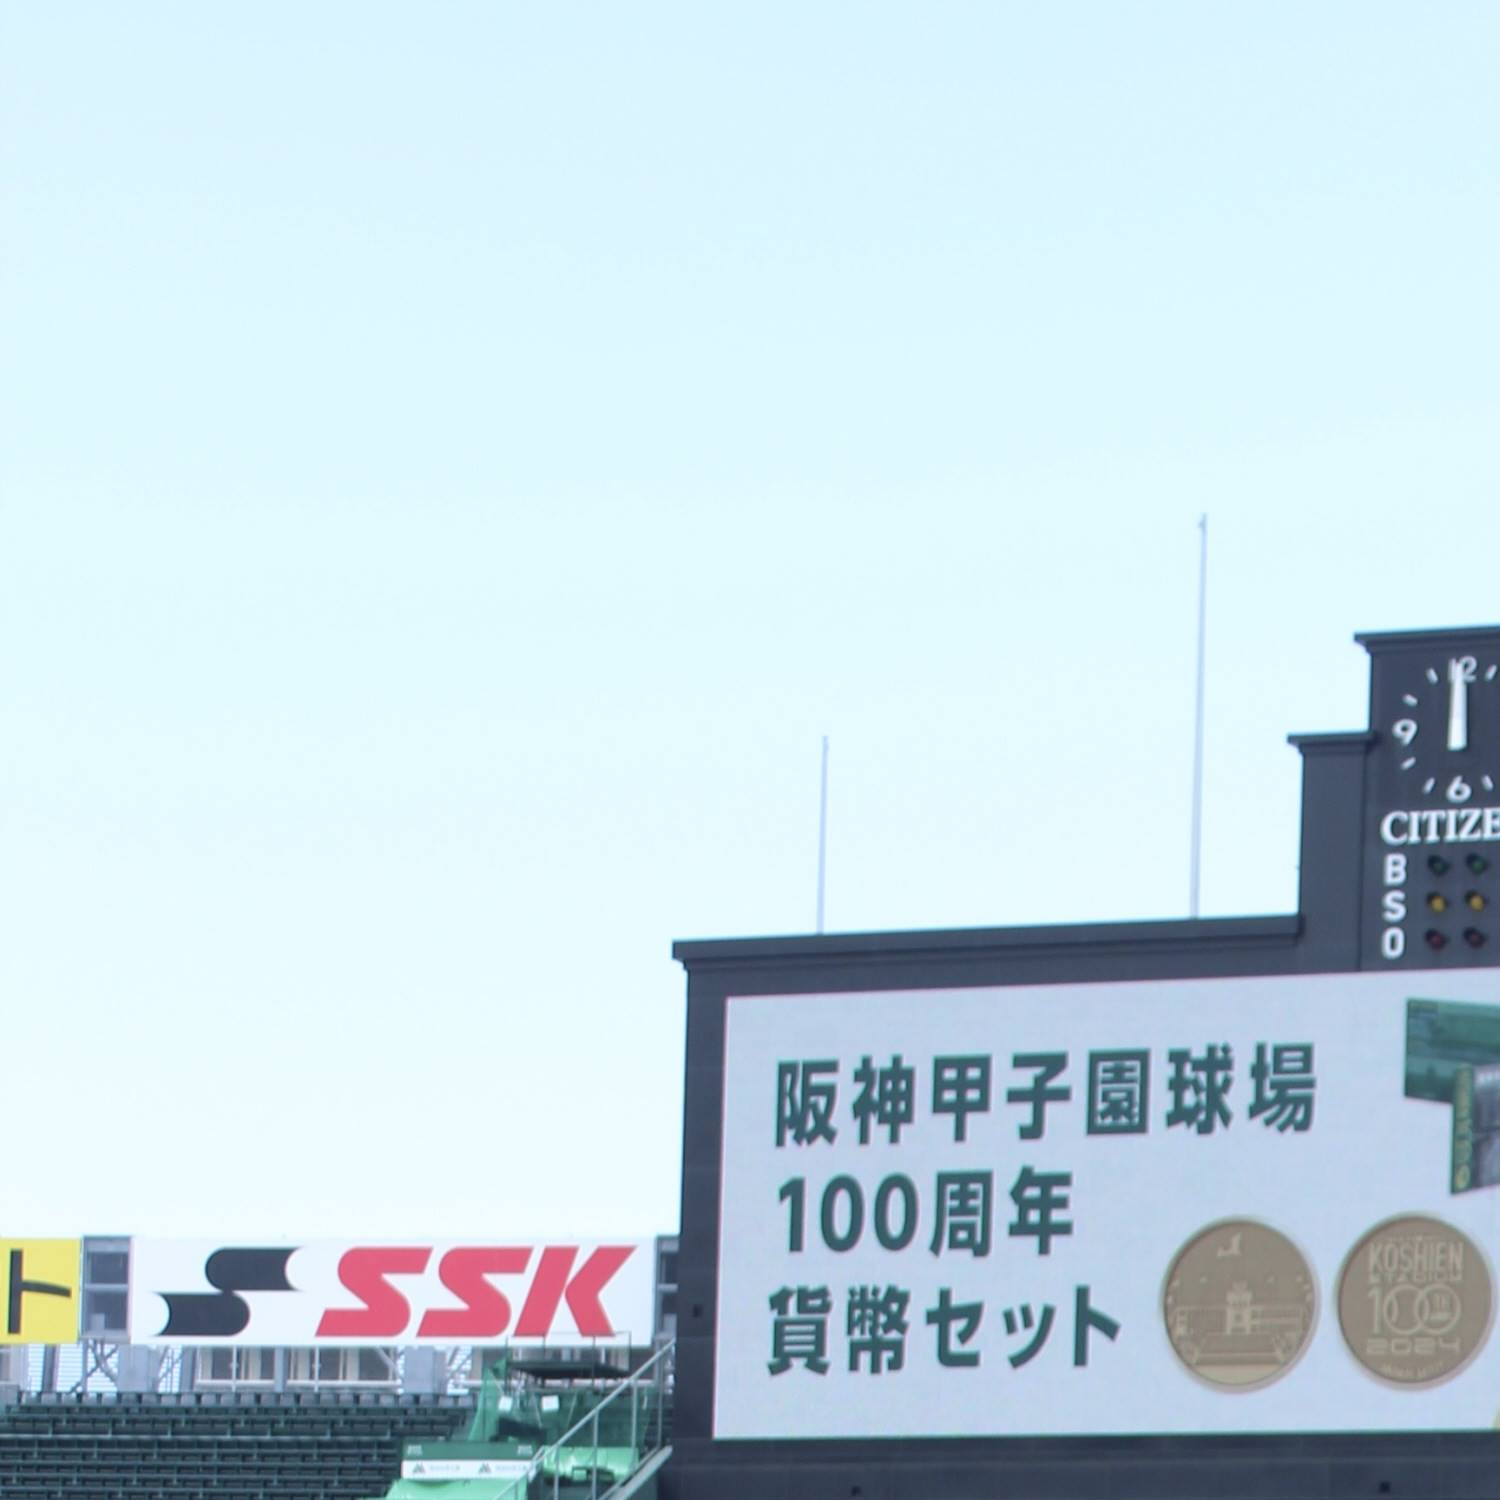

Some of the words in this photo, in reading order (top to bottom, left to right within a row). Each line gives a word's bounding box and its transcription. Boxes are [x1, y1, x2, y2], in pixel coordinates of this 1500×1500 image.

[1449, 656, 1478, 682] 12
[1392, 718, 1418, 744] 9
[1446, 776, 1472, 802] 6
[1384, 853, 1407, 885] B
[1383, 890, 1406, 922] S
[774, 1041, 1318, 1146] 阪神甲子園球場
[776, 1164, 1074, 1258] 100周年
[1368, 1242, 1464, 1272] KOSHIEN
[8, 1248, 72, 1335] ト
[315, 1246, 637, 1338] SSK
[1367, 1283, 1462, 1334] 100
[766, 1284, 1121, 1377] 貨幣セット
